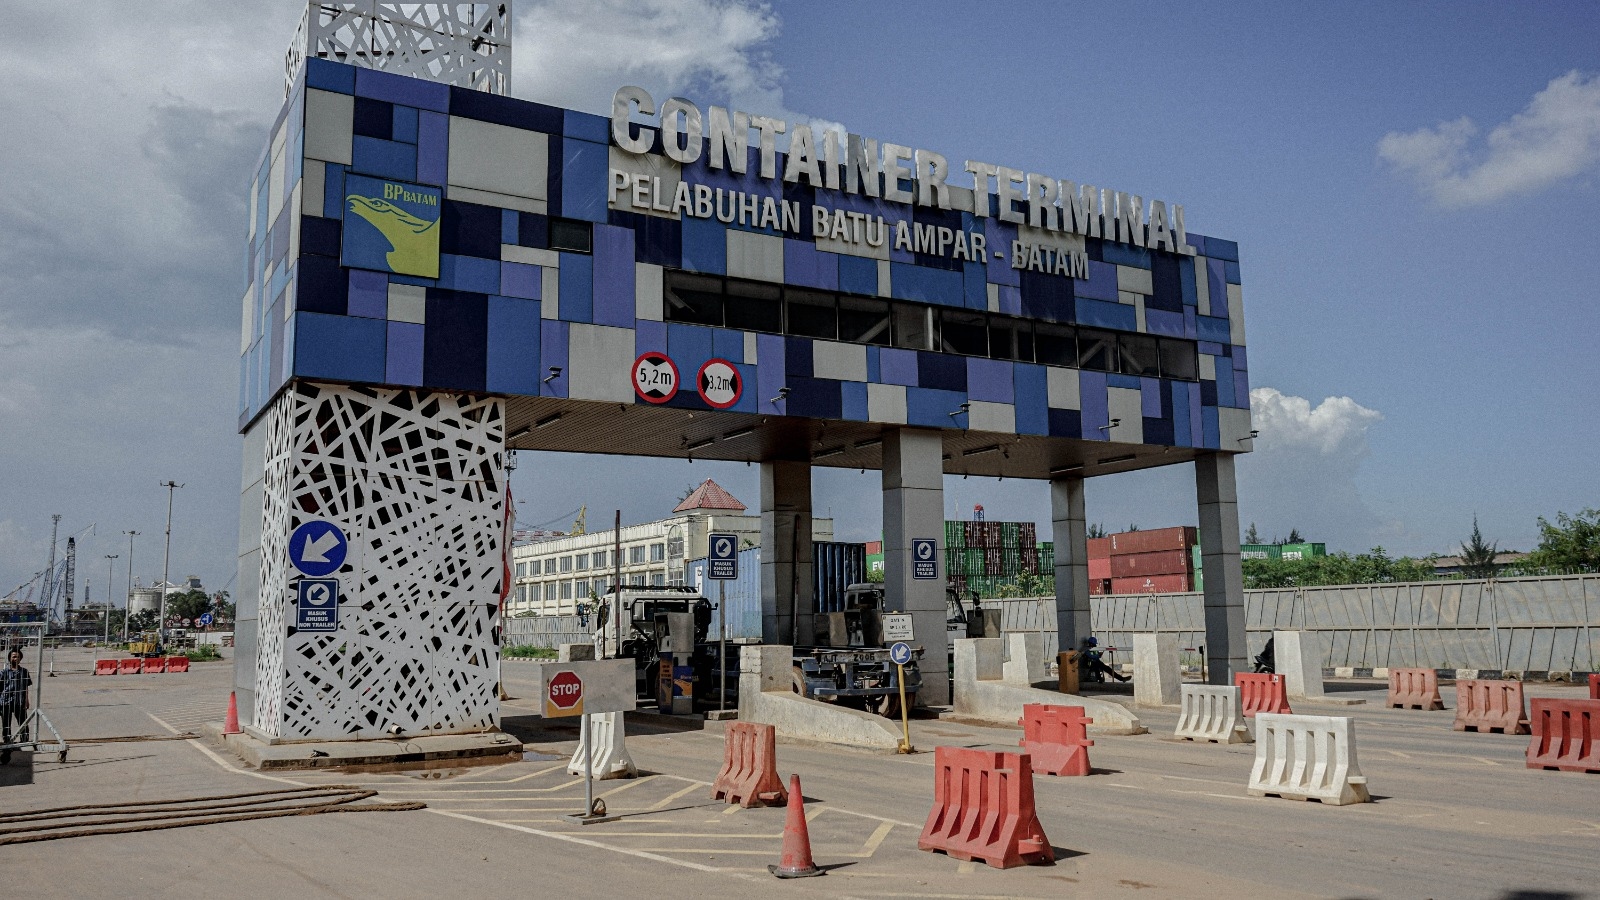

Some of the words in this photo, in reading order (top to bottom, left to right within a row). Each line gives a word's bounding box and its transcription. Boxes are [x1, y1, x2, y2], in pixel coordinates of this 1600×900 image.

[612, 85, 951, 211] CONTAINER
[964, 159, 1197, 257] TERMINAL
[384, 183, 403, 200] BP
[403, 191, 437, 206] BATAM
[608, 168, 800, 234] PELABUHAN
[812, 204, 884, 248] BATU
[894, 219, 987, 264] AMPAR
[1012, 239, 1089, 280] BATAM
[640, 368, 672, 385] 5,2m
[709, 375, 730, 391] 3,2m
[552, 683, 580, 696] STOP
